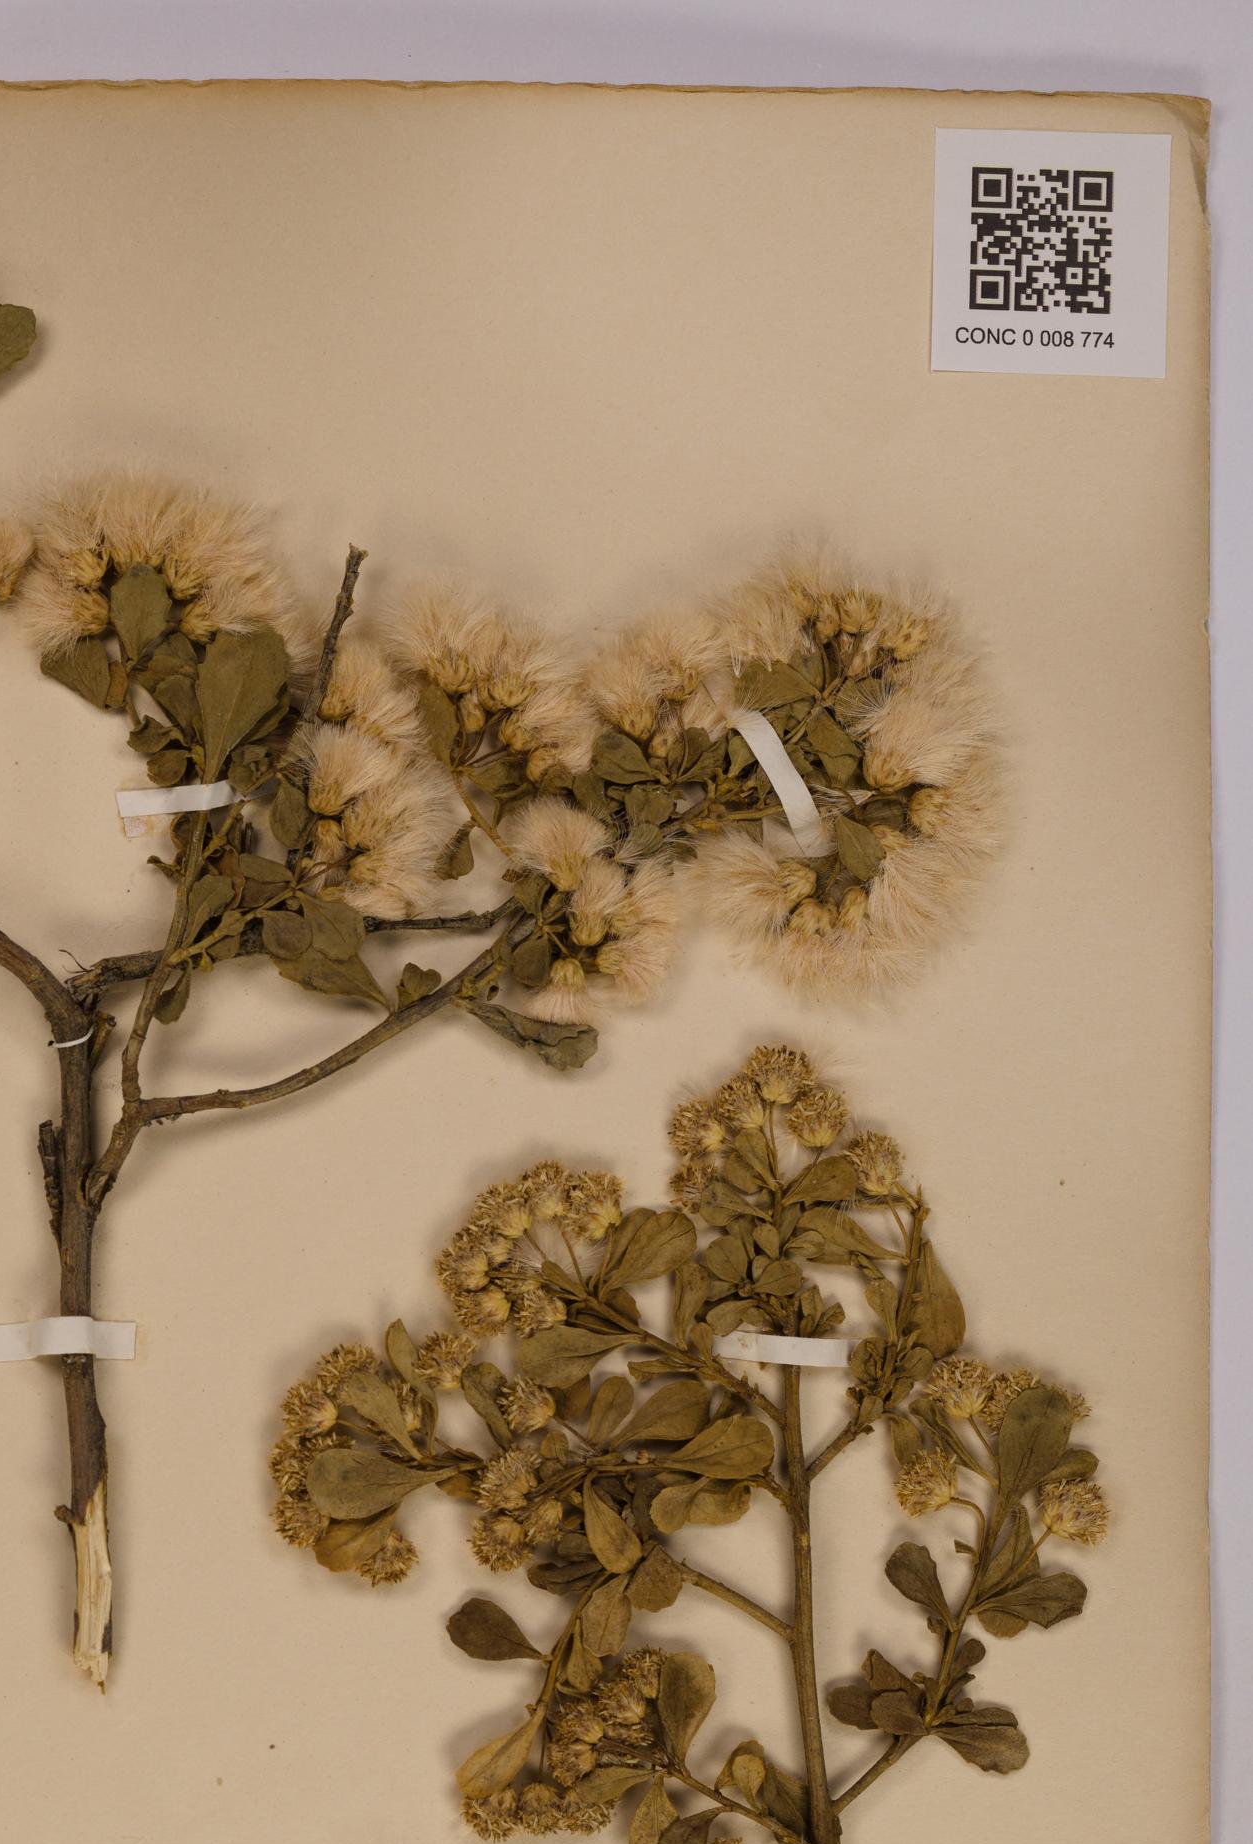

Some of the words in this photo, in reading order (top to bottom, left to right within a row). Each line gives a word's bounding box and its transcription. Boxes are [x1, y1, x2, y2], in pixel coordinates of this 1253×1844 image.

[955, 326, 1016, 346] CONC
[1022, 329, 1034, 346] 0
[1040, 330, 1075, 348] 008
[1080, 331, 1115, 349] 774
